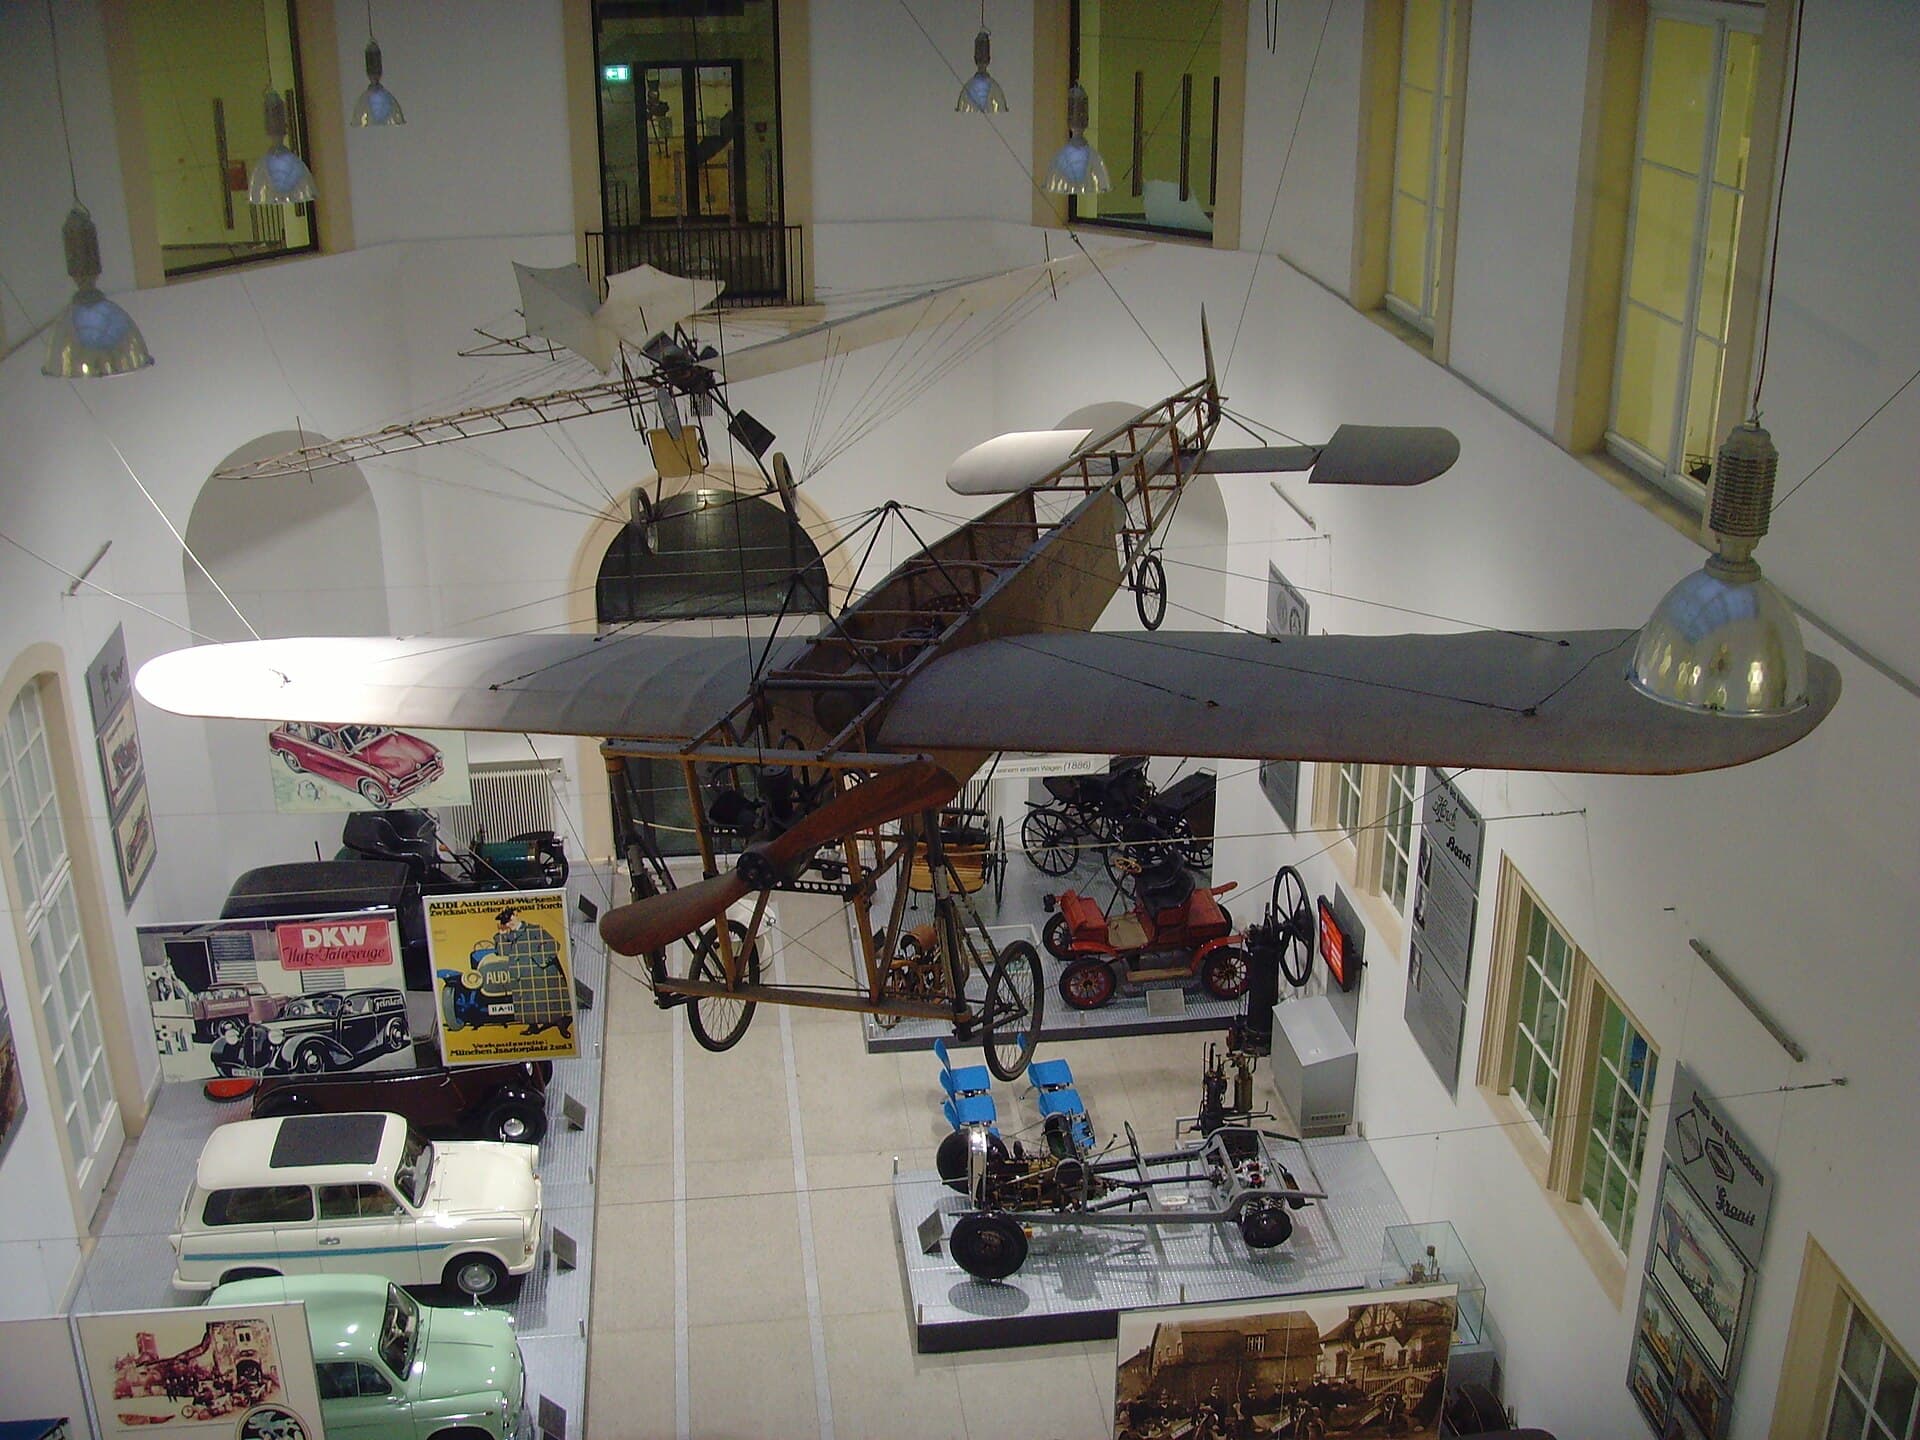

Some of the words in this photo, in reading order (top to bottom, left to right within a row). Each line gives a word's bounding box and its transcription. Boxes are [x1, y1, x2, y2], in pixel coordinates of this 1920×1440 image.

[1063, 761, 1091, 772] (1886)
[429, 901, 460, 911] AUDI
[536, 901, 563, 911] Horch
[302, 925, 368, 949] DKW
[486, 971, 511, 984] AUDI
[450, 1046, 493, 1056] München
[1715, 1185, 1756, 1226] Granit
